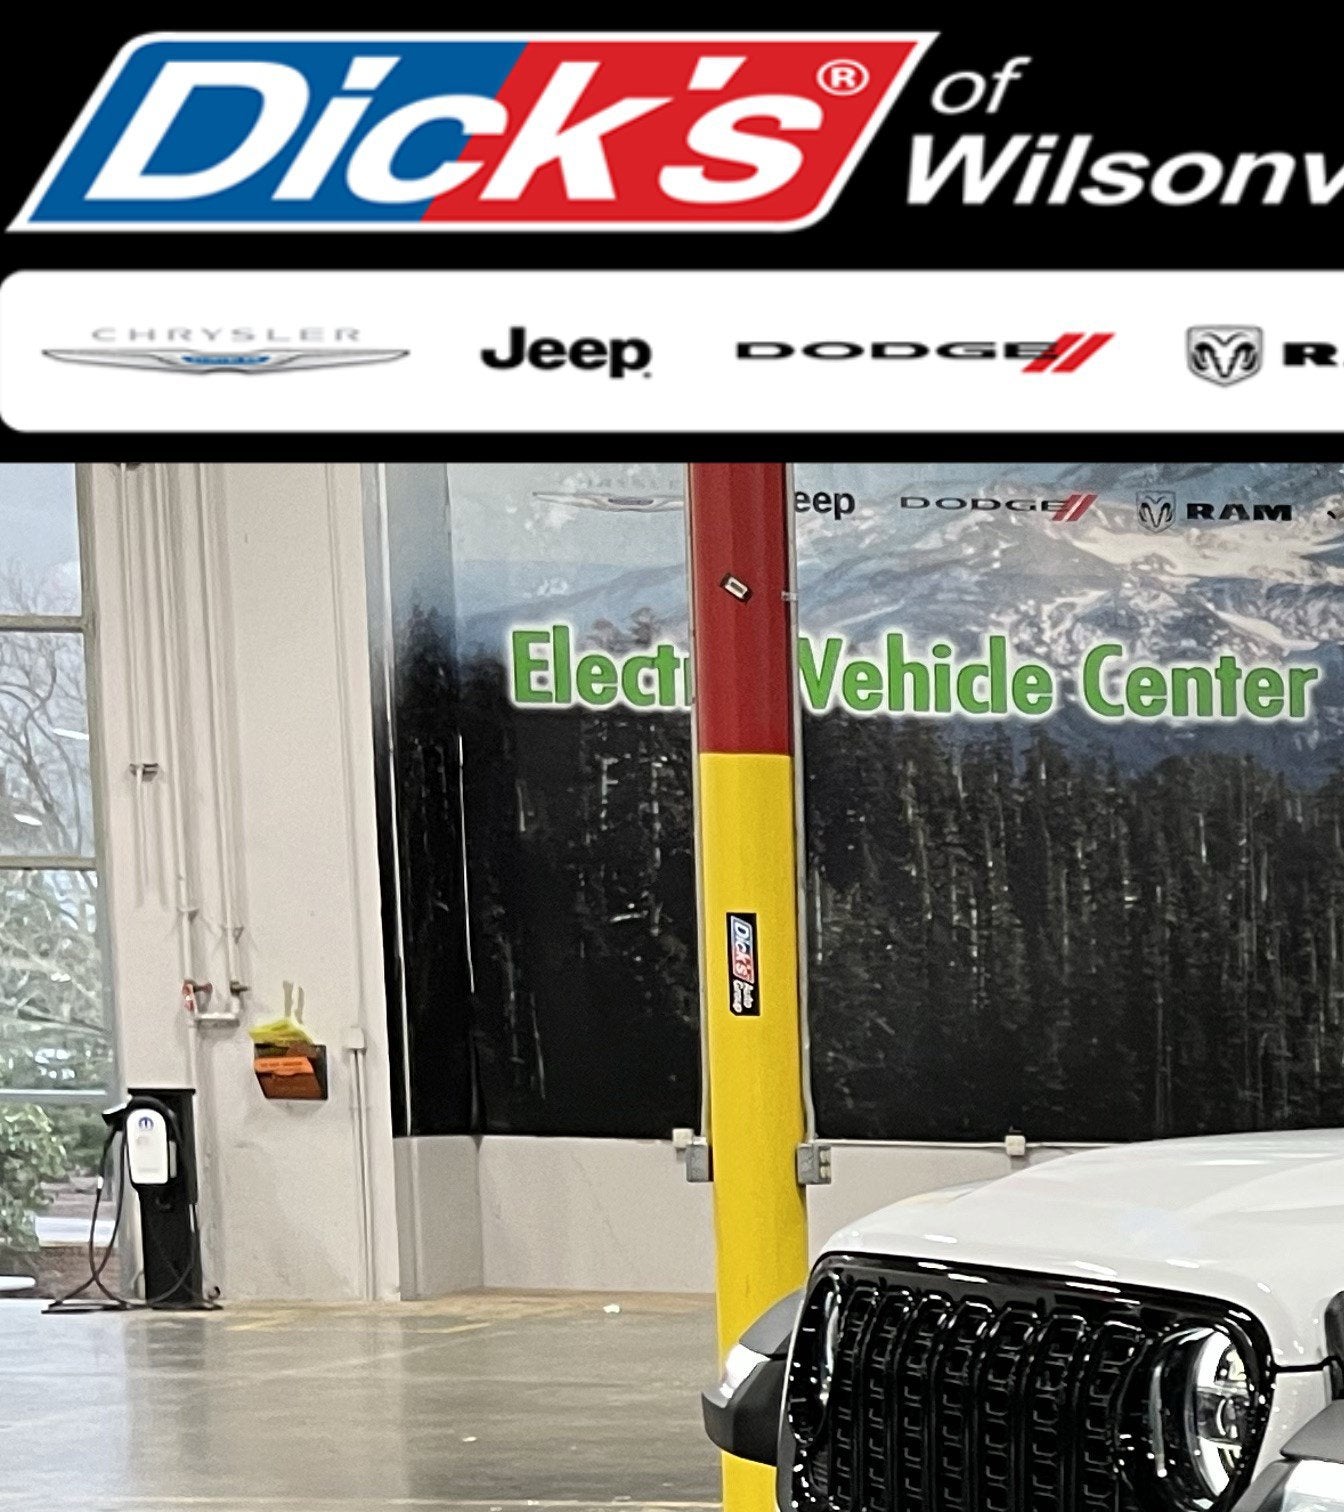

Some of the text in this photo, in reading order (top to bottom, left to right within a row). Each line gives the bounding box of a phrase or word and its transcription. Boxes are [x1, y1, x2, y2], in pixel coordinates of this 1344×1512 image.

[794, 490, 856, 520] eep
[900, 496, 1066, 512] DODGE
[1186, 502, 1292, 522] RAM
[797, 632, 1053, 717] Vehicle
[1082, 642, 1318, 718] Center
